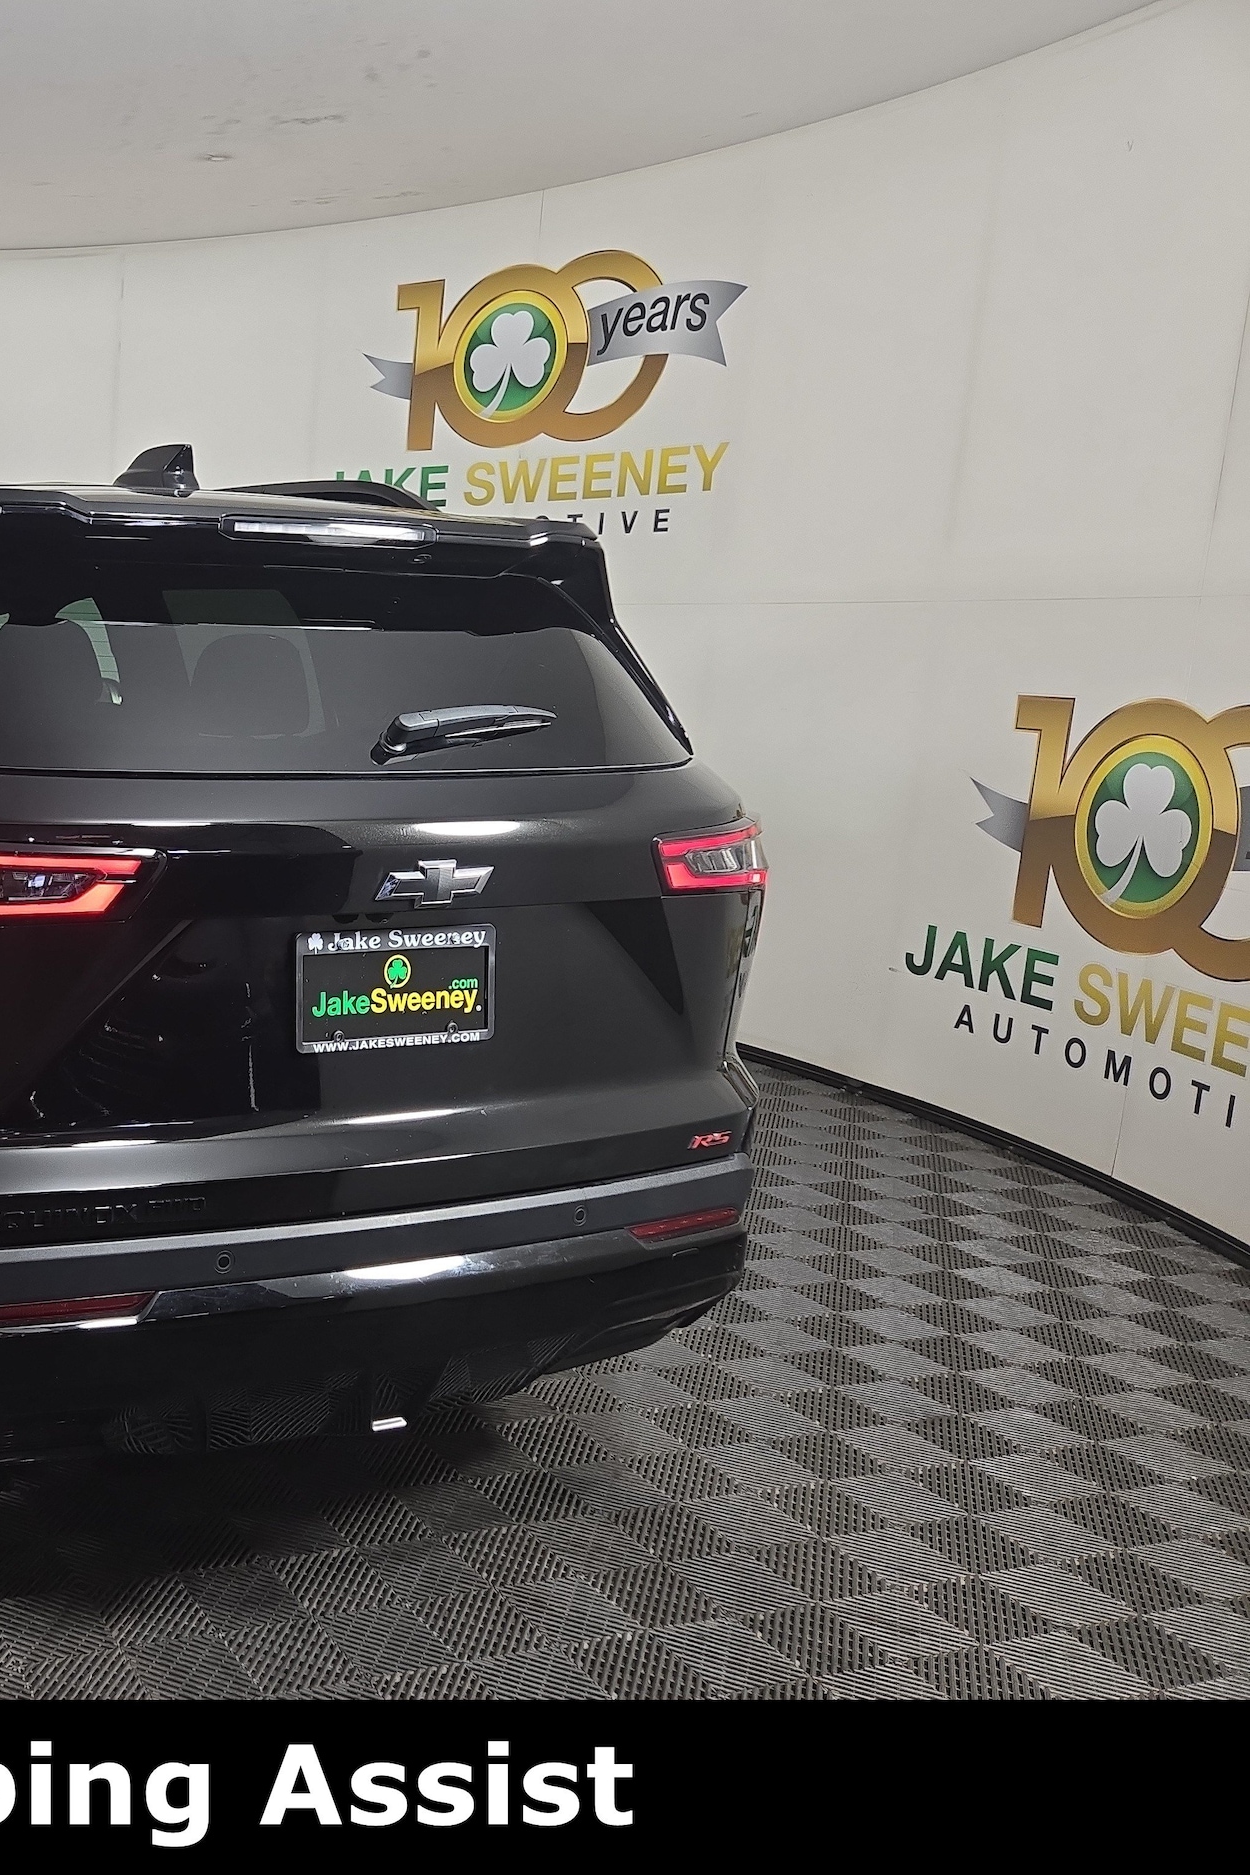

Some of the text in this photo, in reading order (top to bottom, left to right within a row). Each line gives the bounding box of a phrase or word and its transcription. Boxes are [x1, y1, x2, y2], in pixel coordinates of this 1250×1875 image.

[596, 291, 710, 356] years
[463, 442, 730, 506] SWEENEY
[327, 929, 486, 951] Jake Sweeney
[905, 925, 1060, 1012] JAKE
[313, 1032, 480, 1053] WWW.JAKESWEENEY.COM
[687, 1131, 732, 1150] RS
